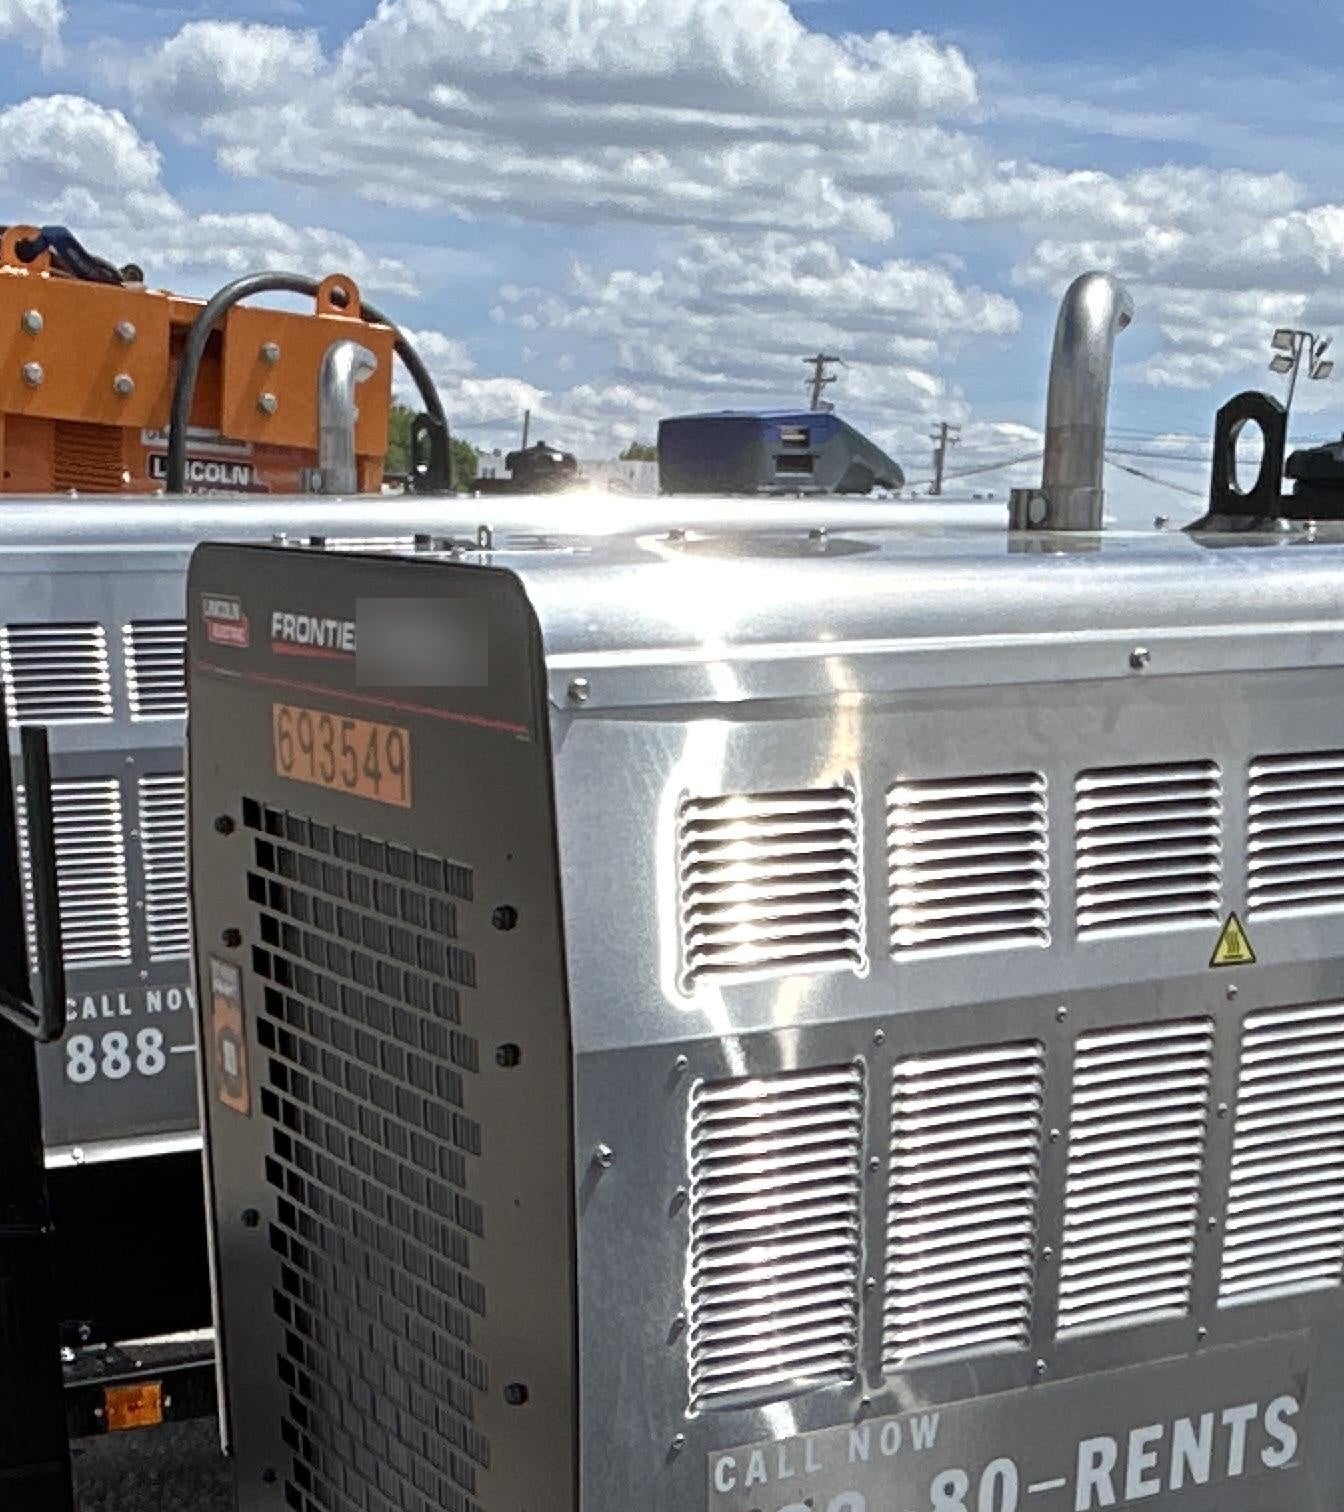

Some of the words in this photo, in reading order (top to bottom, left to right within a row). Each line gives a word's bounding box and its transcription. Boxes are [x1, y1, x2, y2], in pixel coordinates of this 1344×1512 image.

[154, 458, 250, 486] LCOLN
[271, 611, 356, 650] FRONTIE
[276, 706, 406, 801] 693549
[714, 1437, 824, 1493] CALL
[847, 1412, 940, 1464] NOW
